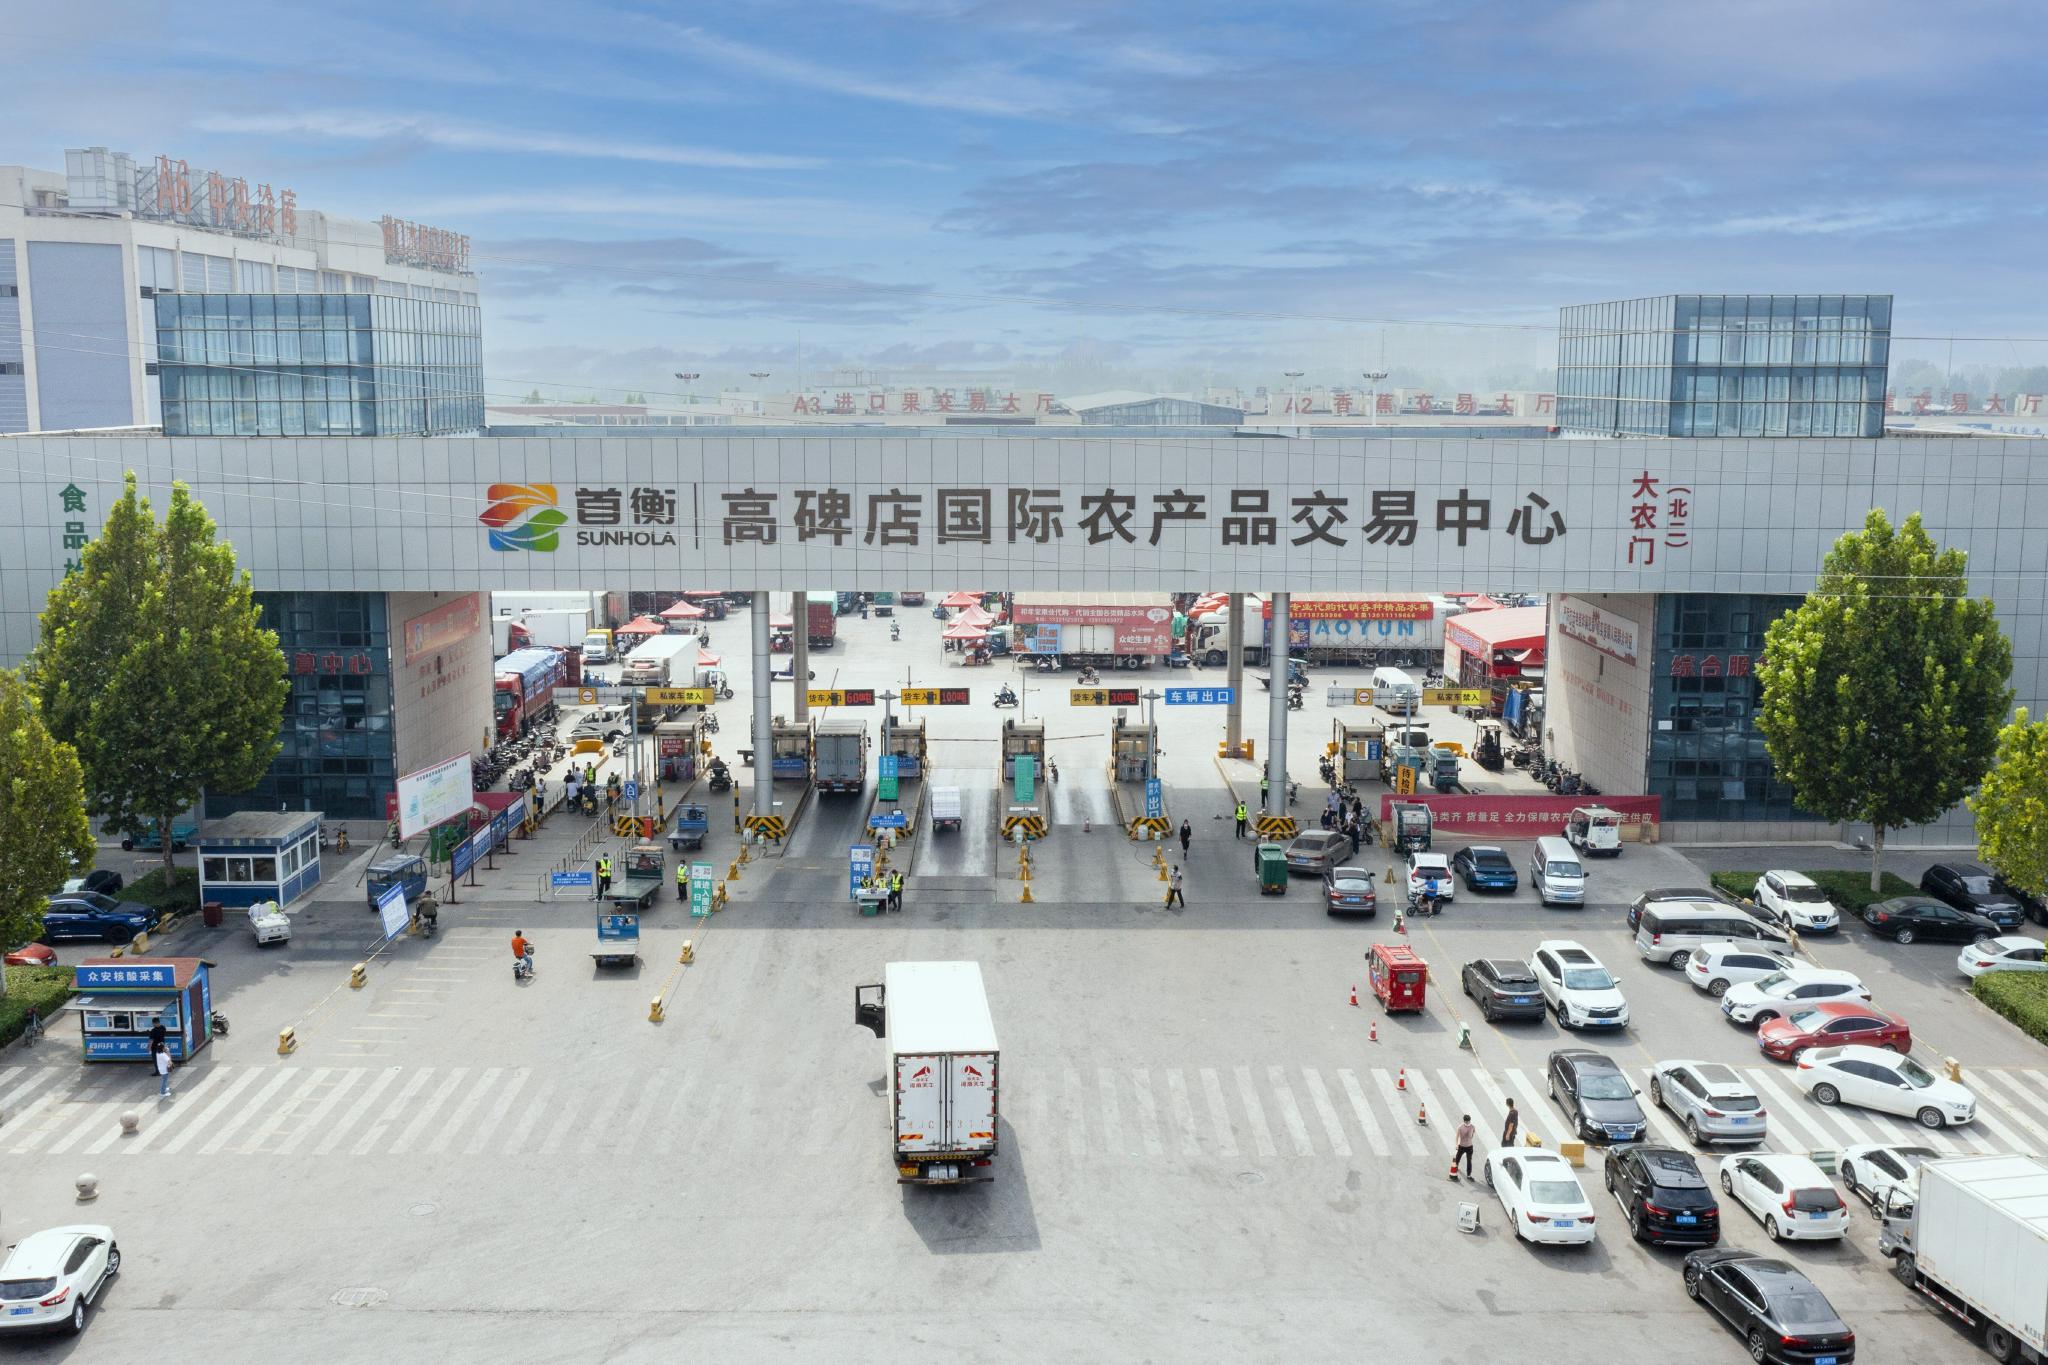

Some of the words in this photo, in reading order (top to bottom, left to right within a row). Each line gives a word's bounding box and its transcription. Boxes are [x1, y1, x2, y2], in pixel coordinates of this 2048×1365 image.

[575, 487, 676, 525] 首衡
[721, 488, 1567, 547] 高碑店国际农产品交易中心
[1628, 470, 1659, 566] 大农门
[576, 531, 676, 546] SUNHOLA
[1315, 619, 1414, 636] AOYUN
[659, 690, 703, 700] 私家车禁入
[1171, 690, 1229, 703] 车辆出口
[1437, 690, 1479, 701] 私家车禁入
[88, 971, 164, 982] 众安核酸采集
